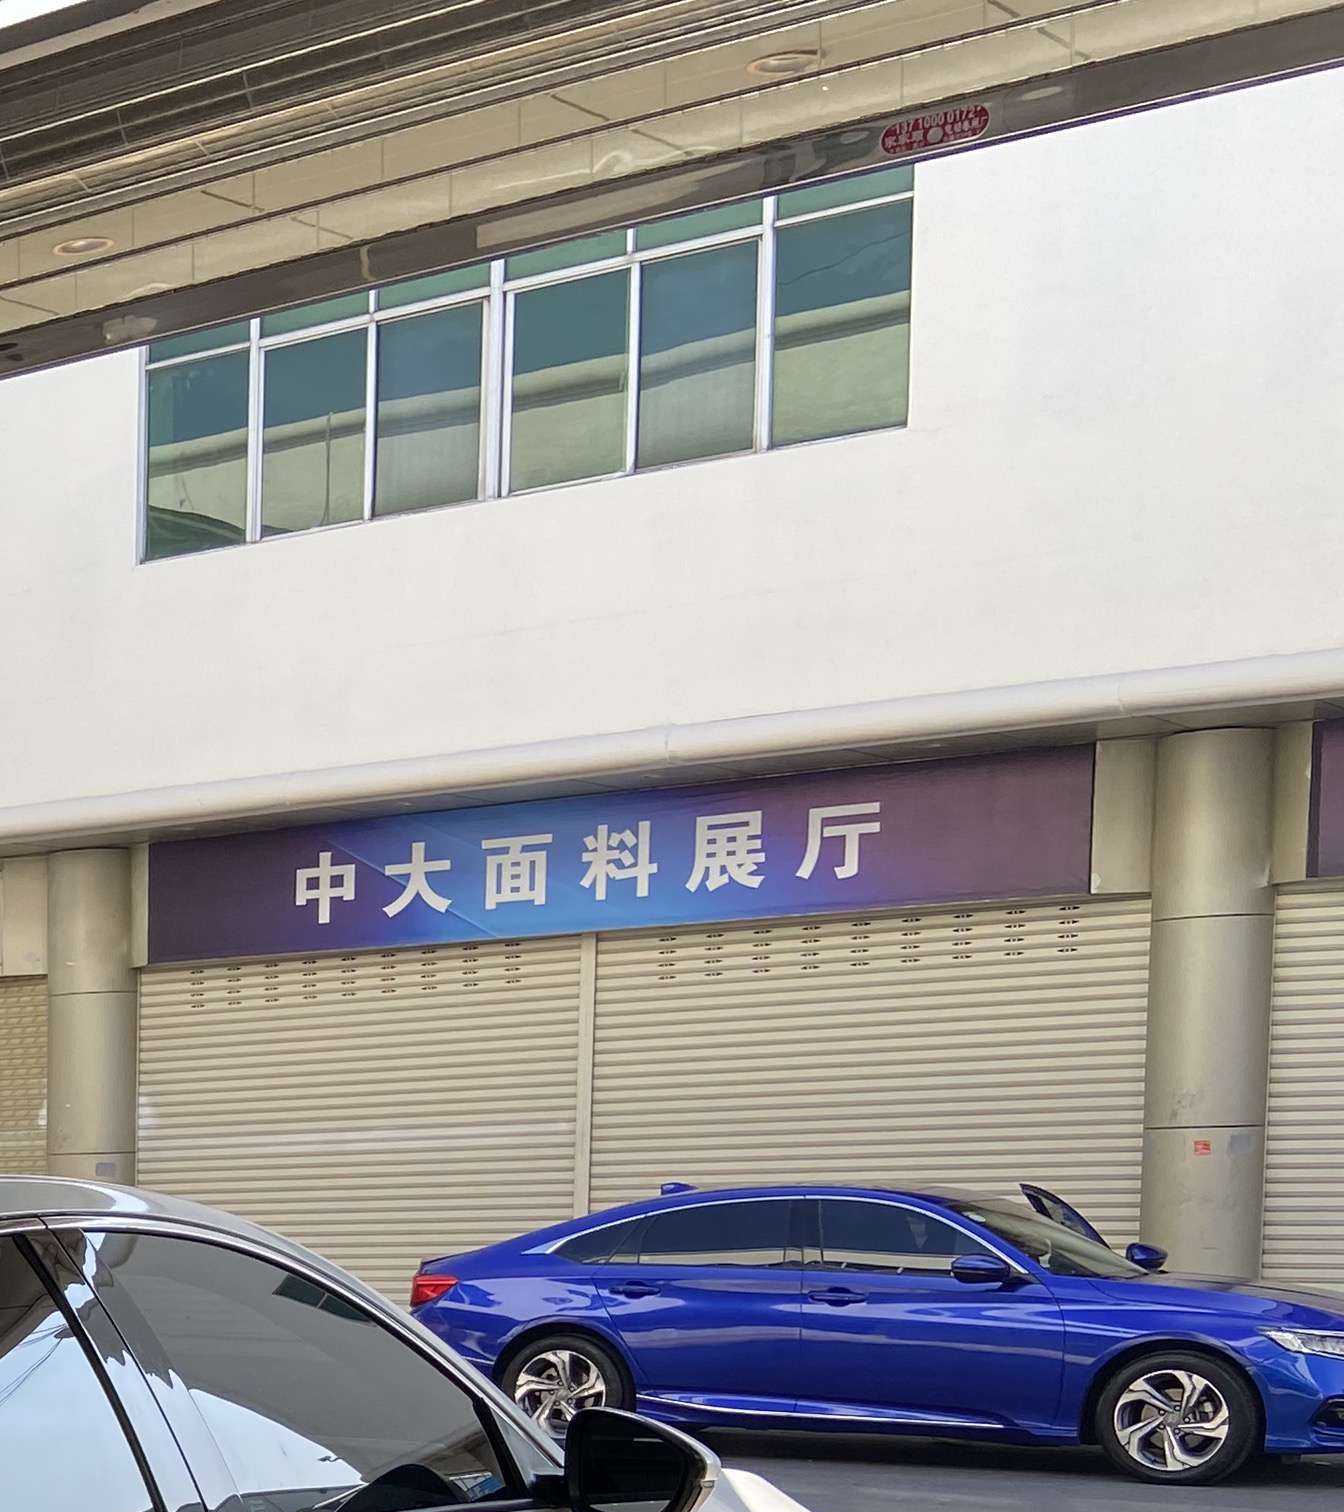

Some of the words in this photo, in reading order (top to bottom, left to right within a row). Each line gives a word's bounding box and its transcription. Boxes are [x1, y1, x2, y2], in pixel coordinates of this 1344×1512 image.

[294, 801, 883, 925] 中大面料展厅
